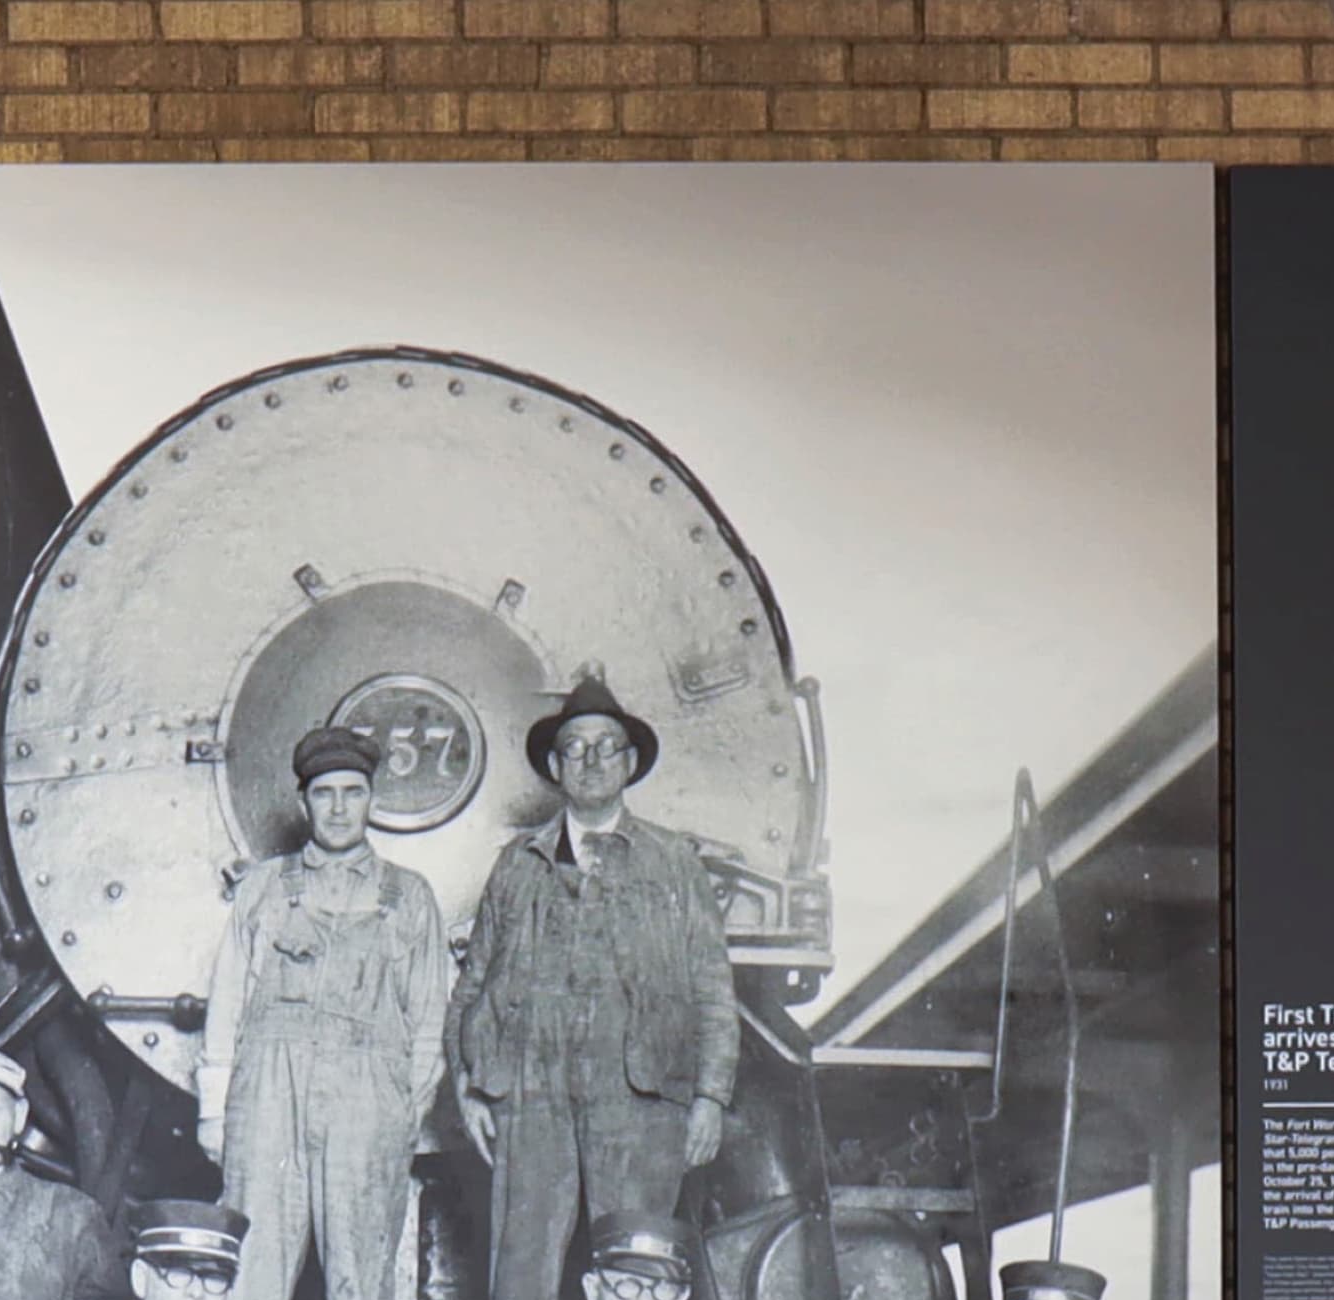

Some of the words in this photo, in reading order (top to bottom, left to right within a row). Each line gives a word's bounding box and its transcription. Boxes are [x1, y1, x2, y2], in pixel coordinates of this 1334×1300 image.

[351, 726, 456, 777] 57
[1263, 1003, 1315, 1025] First
[1263, 1051, 1310, 1072] T&P
[1264, 1078, 1288, 1091] 1931
[1263, 1118, 1283, 1131] The
[1287, 1118, 1310, 1131] Fort
[1263, 1147, 1285, 1159] that
[1276, 1161, 1295, 1173] the
[1263, 1175, 1306, 1187] October
[1263, 1189, 1281, 1201] the
[1284, 1189, 1321, 1201] arrival
[1323, 1189, 1334, 1201] of
[1263, 1204, 1290, 1215] train
[1316, 1203, 1334, 1215] the
[1263, 1217, 1287, 1230] T&P
